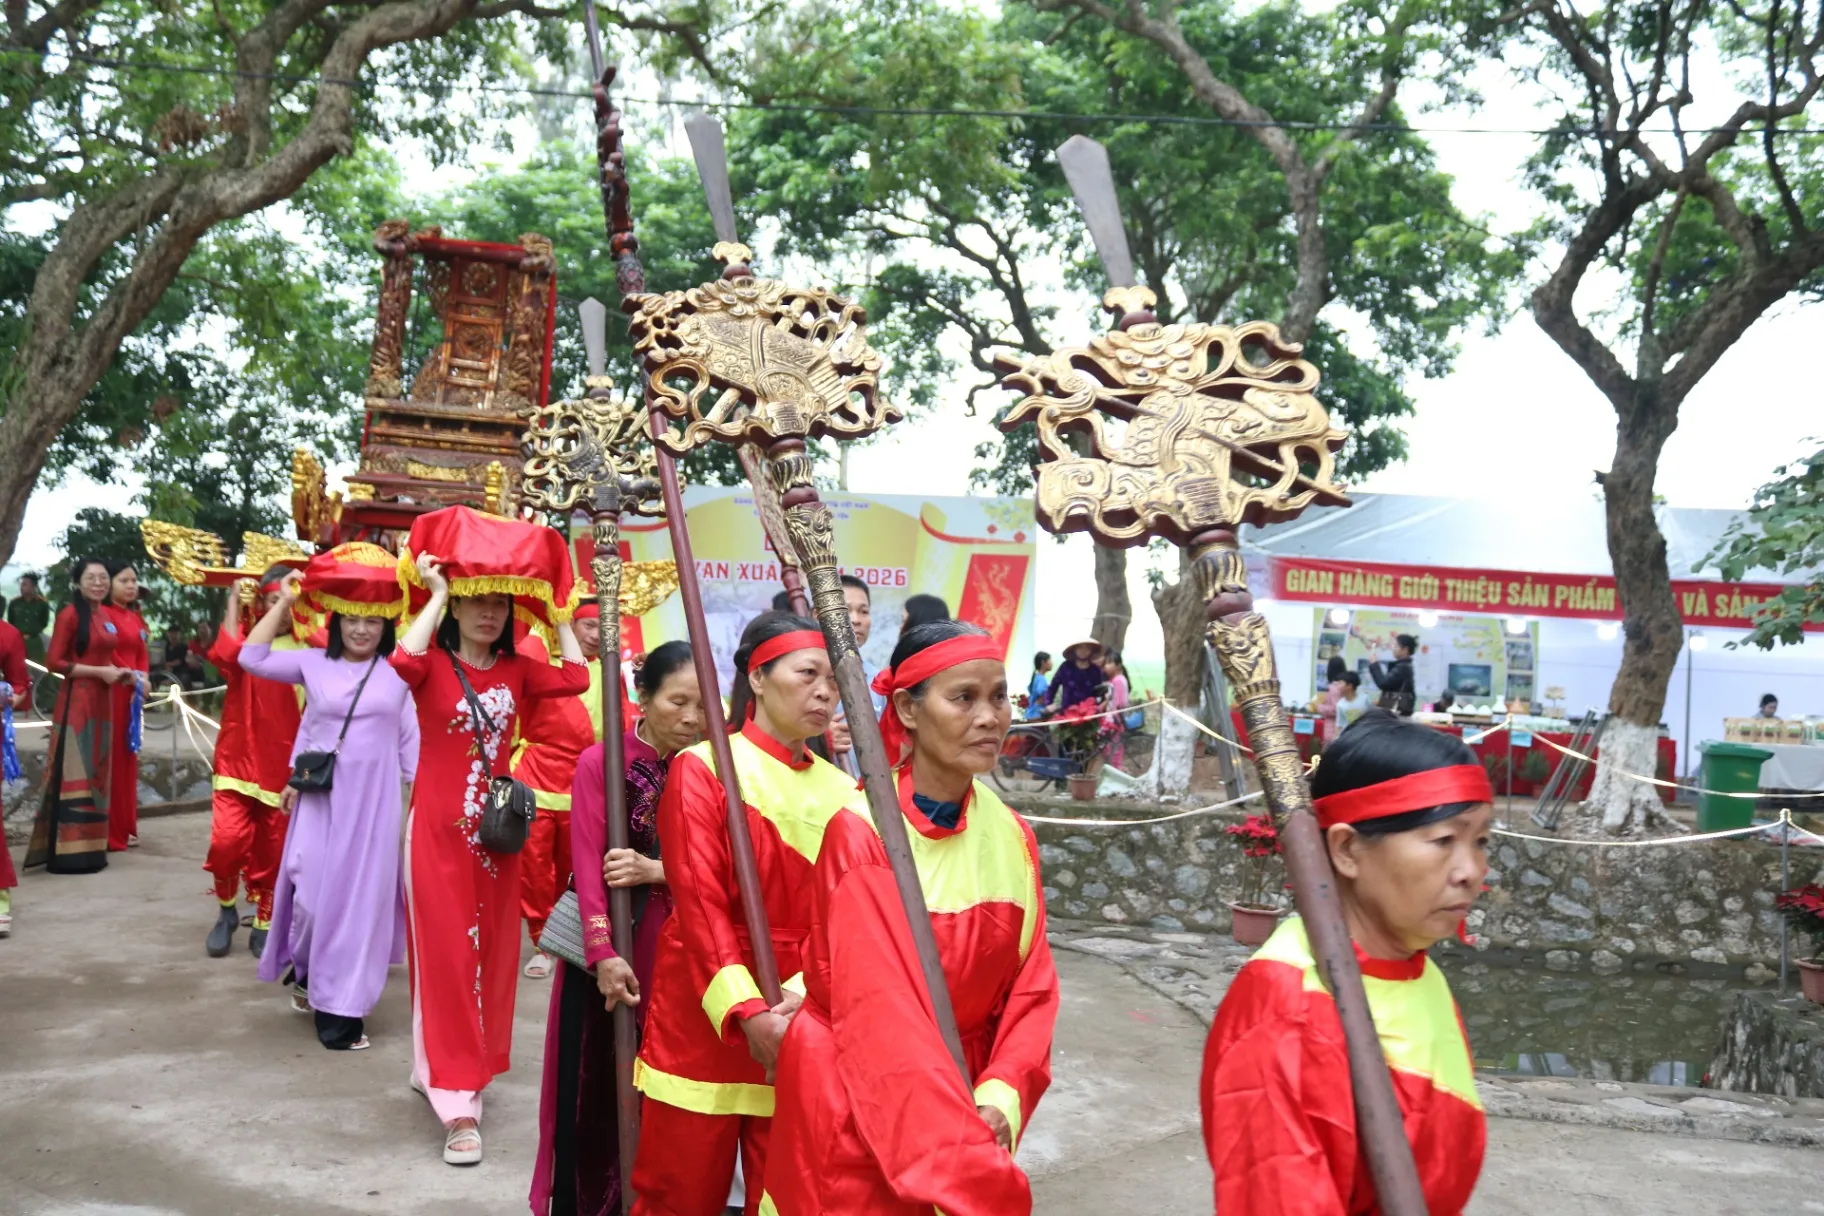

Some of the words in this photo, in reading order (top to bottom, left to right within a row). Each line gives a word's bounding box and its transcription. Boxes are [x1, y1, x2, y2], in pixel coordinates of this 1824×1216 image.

[738, 560, 783, 581] XUÂ
[854, 567, 907, 586] 2026
[1286, 569, 1334, 594] GIAN
[1338, 568, 1394, 598] HÀNG
[1399, 573, 1440, 601] GIỚI
[1444, 576, 1502, 609] THIỆU
[1507, 576, 1549, 608] SẢN
[1554, 577, 1616, 611] PHẨM
[1682, 588, 1709, 617] VÀ
